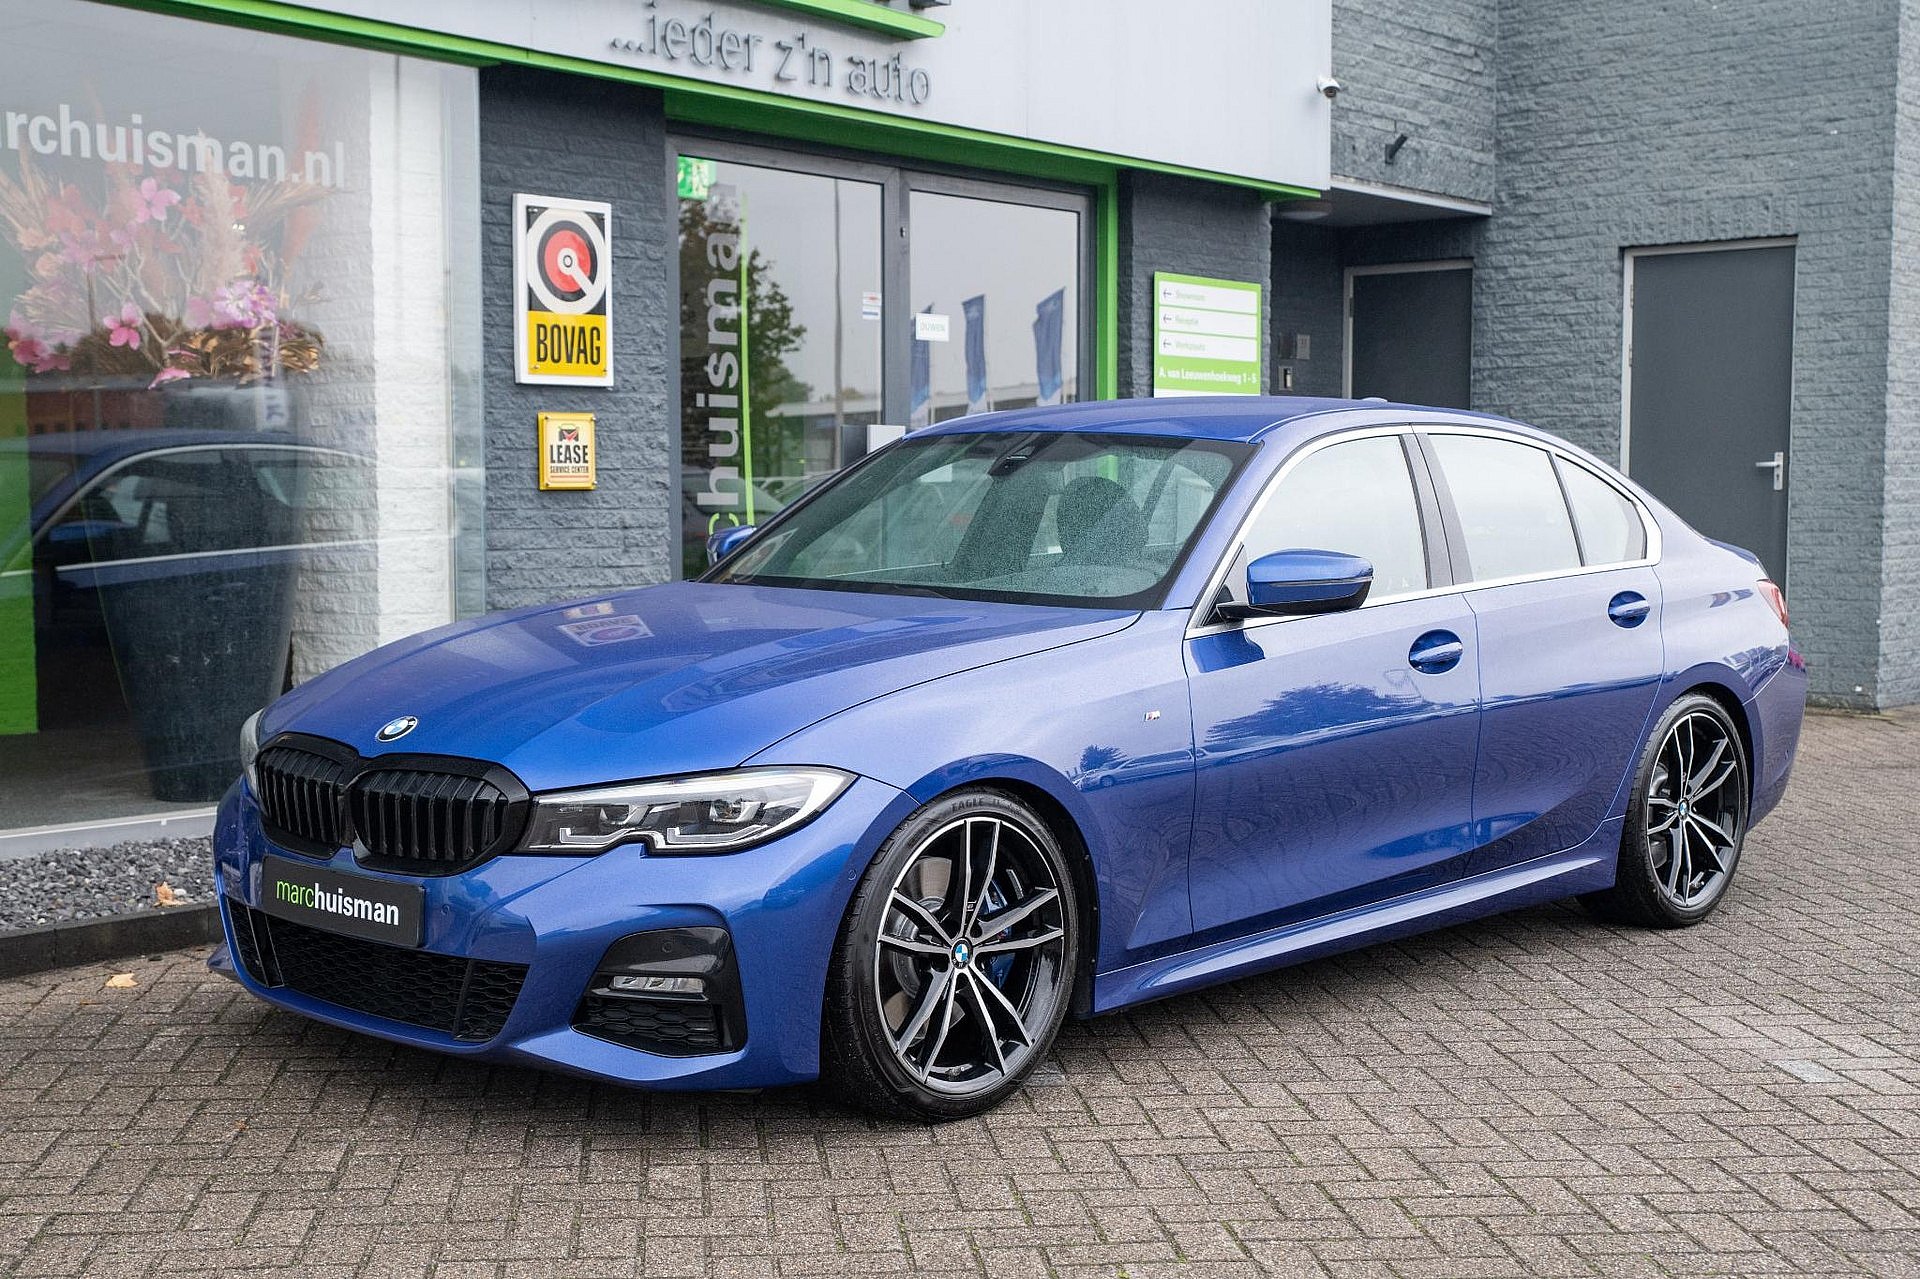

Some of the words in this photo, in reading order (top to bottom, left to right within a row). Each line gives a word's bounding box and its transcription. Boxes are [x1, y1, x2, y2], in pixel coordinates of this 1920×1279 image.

[774, 32, 833, 88] z'n
[847, 50, 930, 105] auto
[0, 103, 344, 188] rchuisman.nl
[536, 323, 601, 366] BOVAG
[550, 444, 589, 464] LEASE
[550, 464, 570, 474] SERVICE
[571, 464, 589, 475] CENTER
[276, 879, 399, 926] marchuisman
